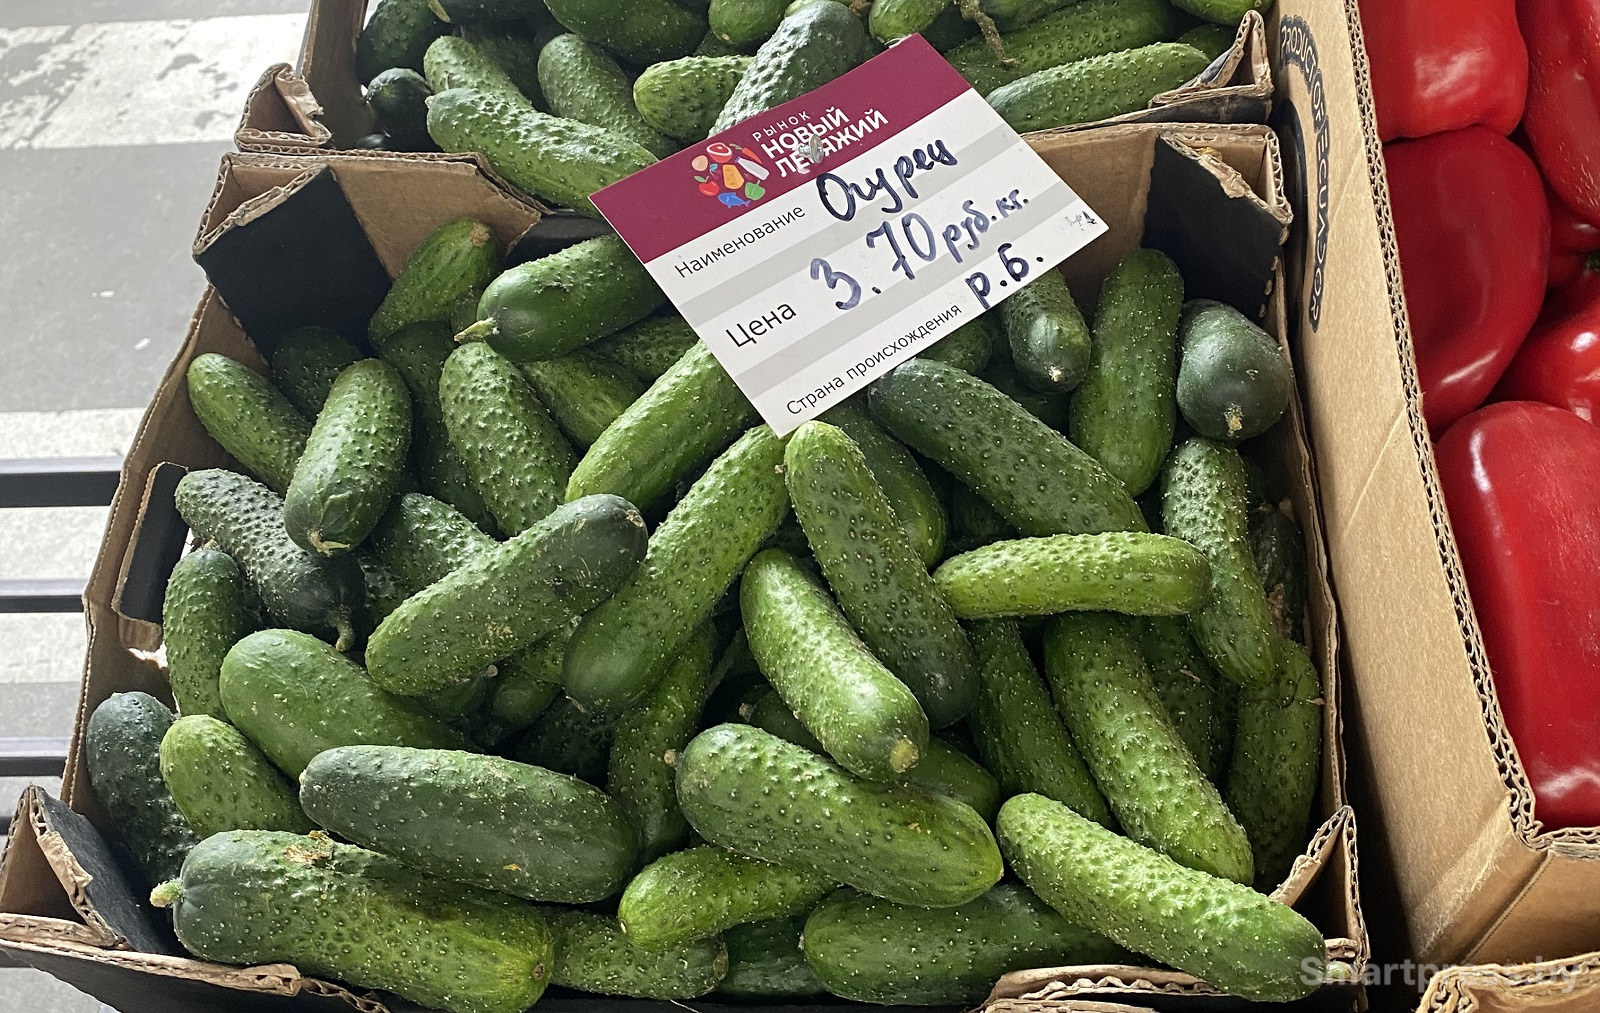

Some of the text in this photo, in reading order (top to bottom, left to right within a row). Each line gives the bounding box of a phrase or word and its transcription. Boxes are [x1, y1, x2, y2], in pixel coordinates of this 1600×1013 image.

[752, 111, 810, 142] РЫНОК
[761, 106, 850, 159] НОВЫЙ
[1313, 80, 1325, 122] OF
[775, 109, 889, 178] ЛЕЯЖИЙ
[816, 139, 958, 222] Огурец
[674, 206, 806, 278] Наименование
[1310, 127, 1328, 322] ECUADOR
[725, 303, 797, 348] Цена
[786, 304, 962, 415] Страна происхождения
